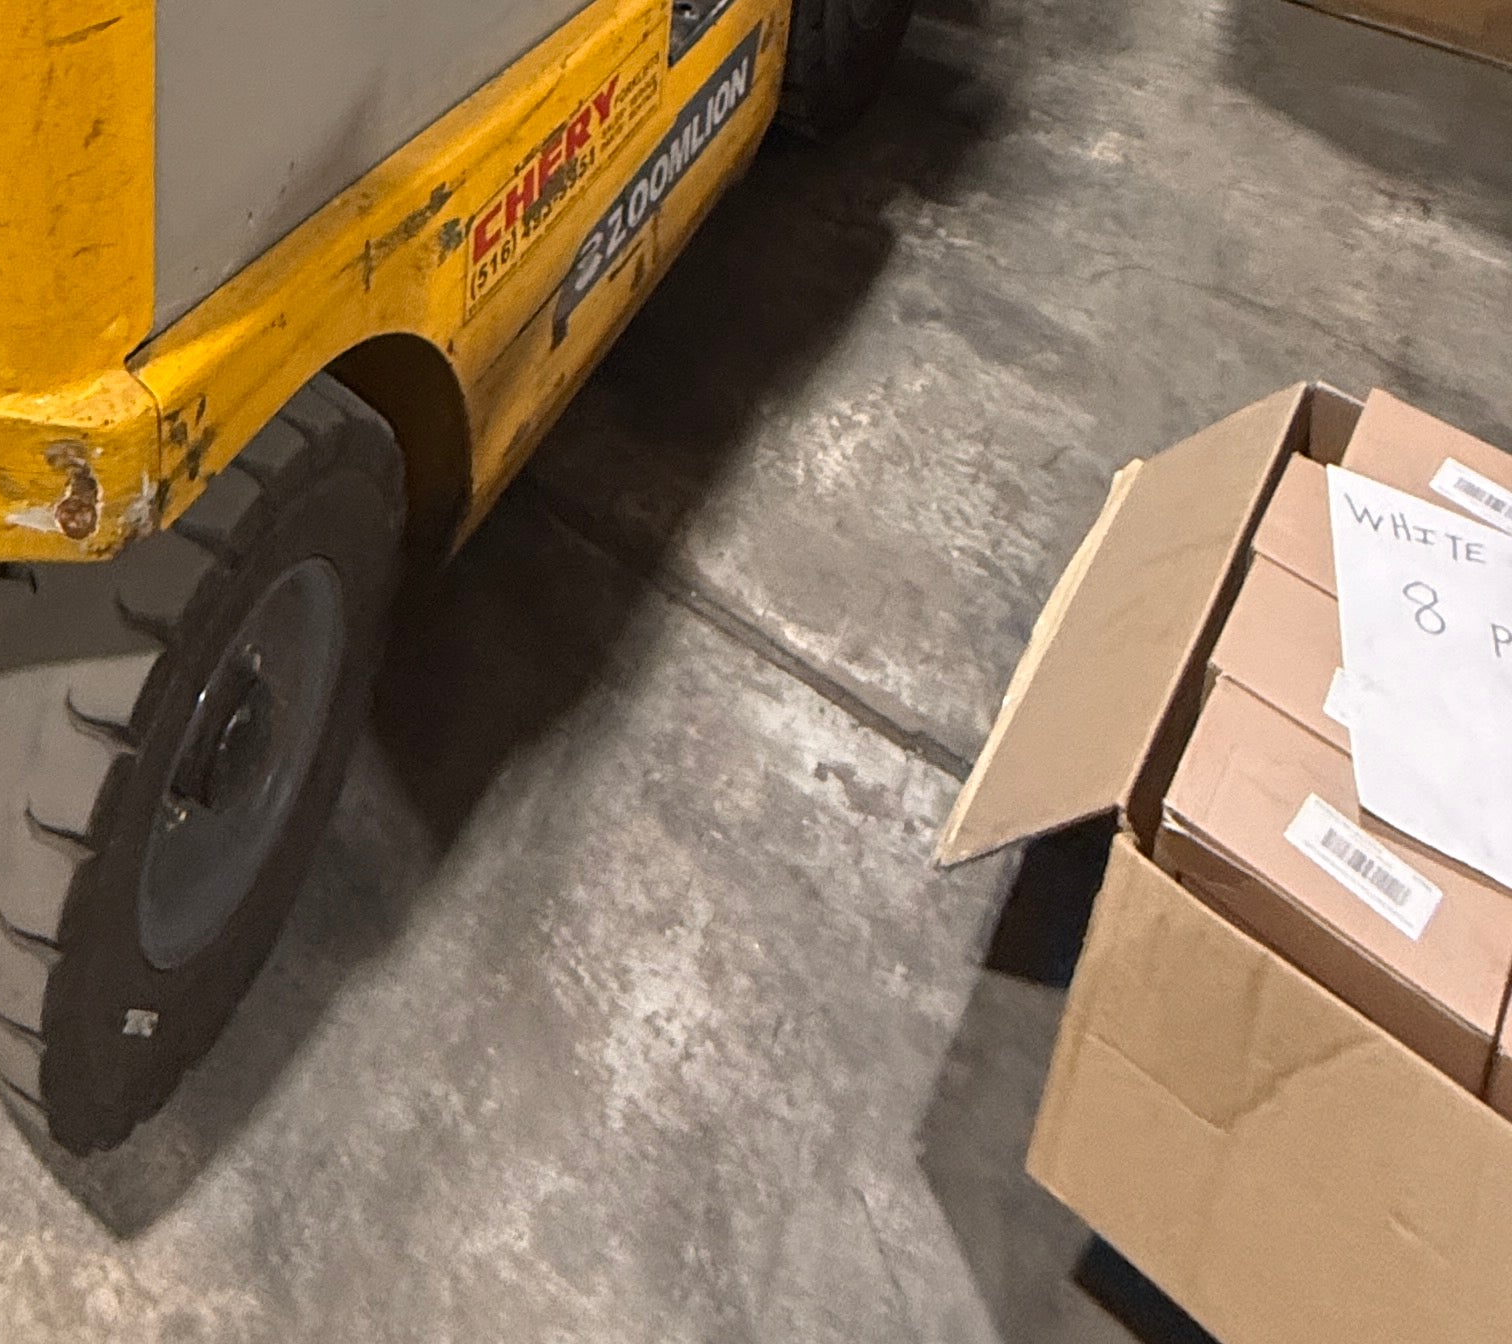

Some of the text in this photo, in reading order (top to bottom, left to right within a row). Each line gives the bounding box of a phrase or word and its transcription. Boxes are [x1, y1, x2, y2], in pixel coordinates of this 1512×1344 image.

[473, 74, 619, 263] CHERY
[605, 56, 750, 259] ZOOMLION
[470, 231, 517, 301] (516)
[1343, 492, 1486, 564] WHITE
[1402, 580, 1446, 635] 8
